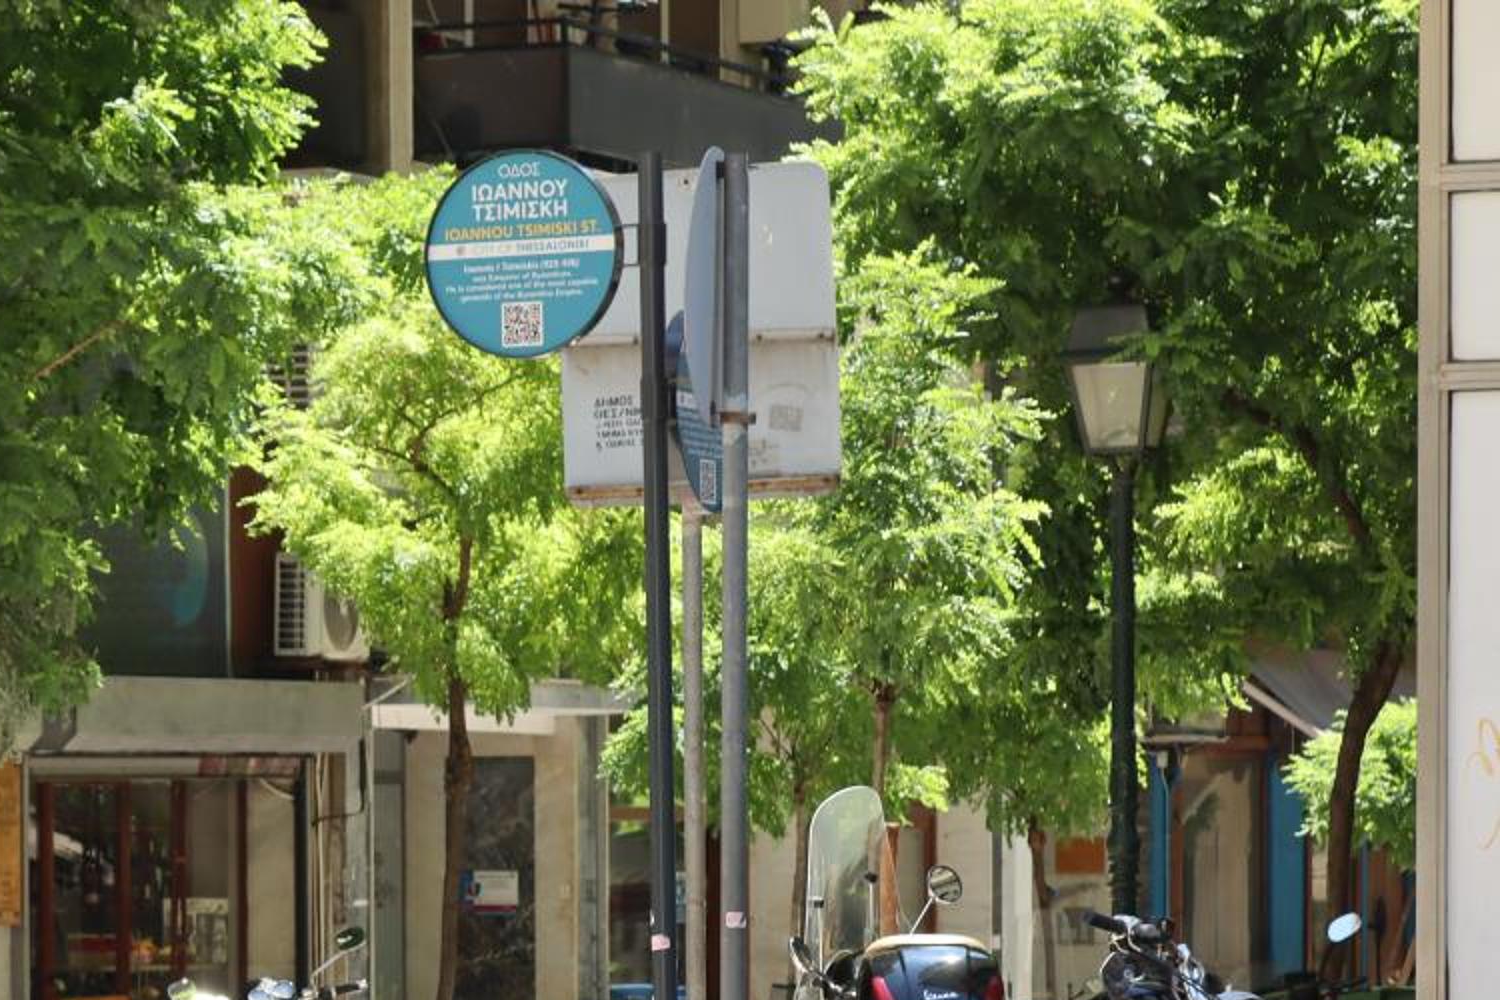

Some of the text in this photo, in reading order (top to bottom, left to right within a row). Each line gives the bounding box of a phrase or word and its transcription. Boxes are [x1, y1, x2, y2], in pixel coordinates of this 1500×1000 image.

[497, 162, 540, 178] ΟΔΟΣ
[471, 179, 568, 203] ΙΩΑΝΝΟΥ
[472, 200, 568, 223] ΤΣΙΜΙΣΚΗ
[445, 226, 514, 241] IOANNOU
[516, 222, 577, 237] TSIMISKI
